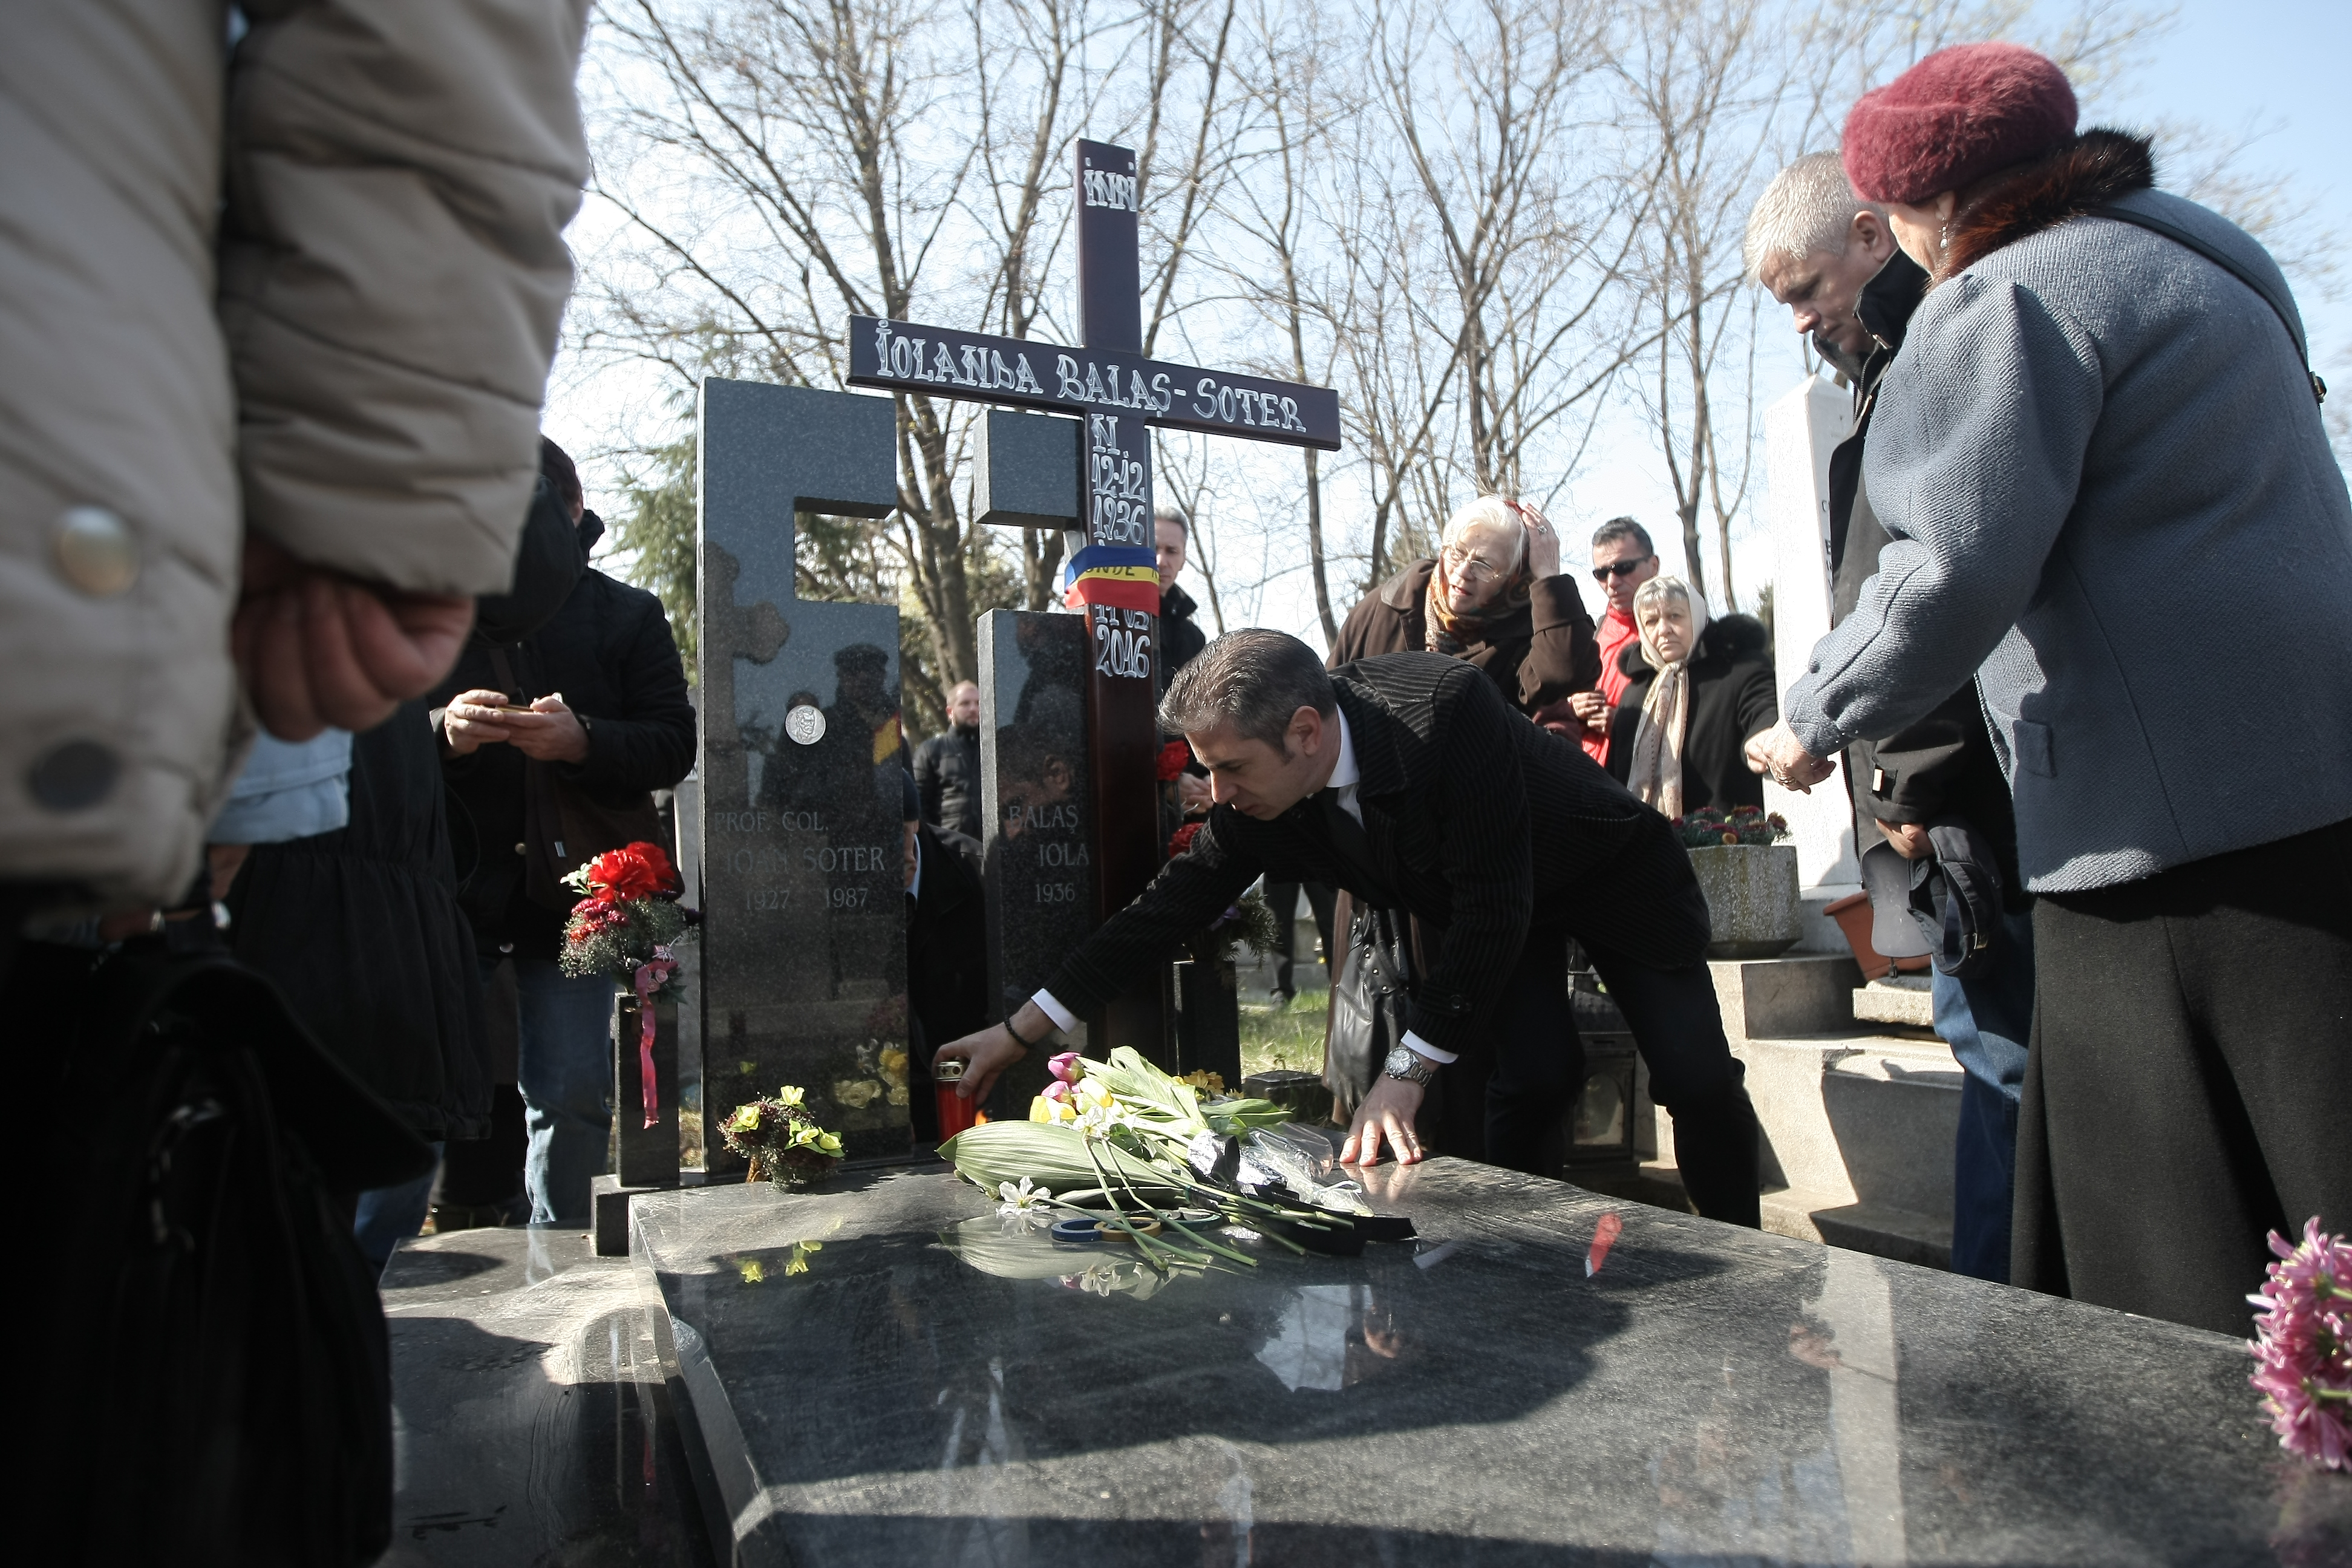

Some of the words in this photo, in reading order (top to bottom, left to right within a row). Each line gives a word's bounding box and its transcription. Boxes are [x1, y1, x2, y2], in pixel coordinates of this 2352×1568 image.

[1093, 495, 1146, 545] 1936
[1095, 624, 1151, 678] 2016
[782, 811, 829, 832] COL.
[803, 847, 885, 872] SOTER
[746, 889, 790, 910] 1927
[825, 887, 869, 909] 1987
[1034, 882, 1076, 903] 1936
